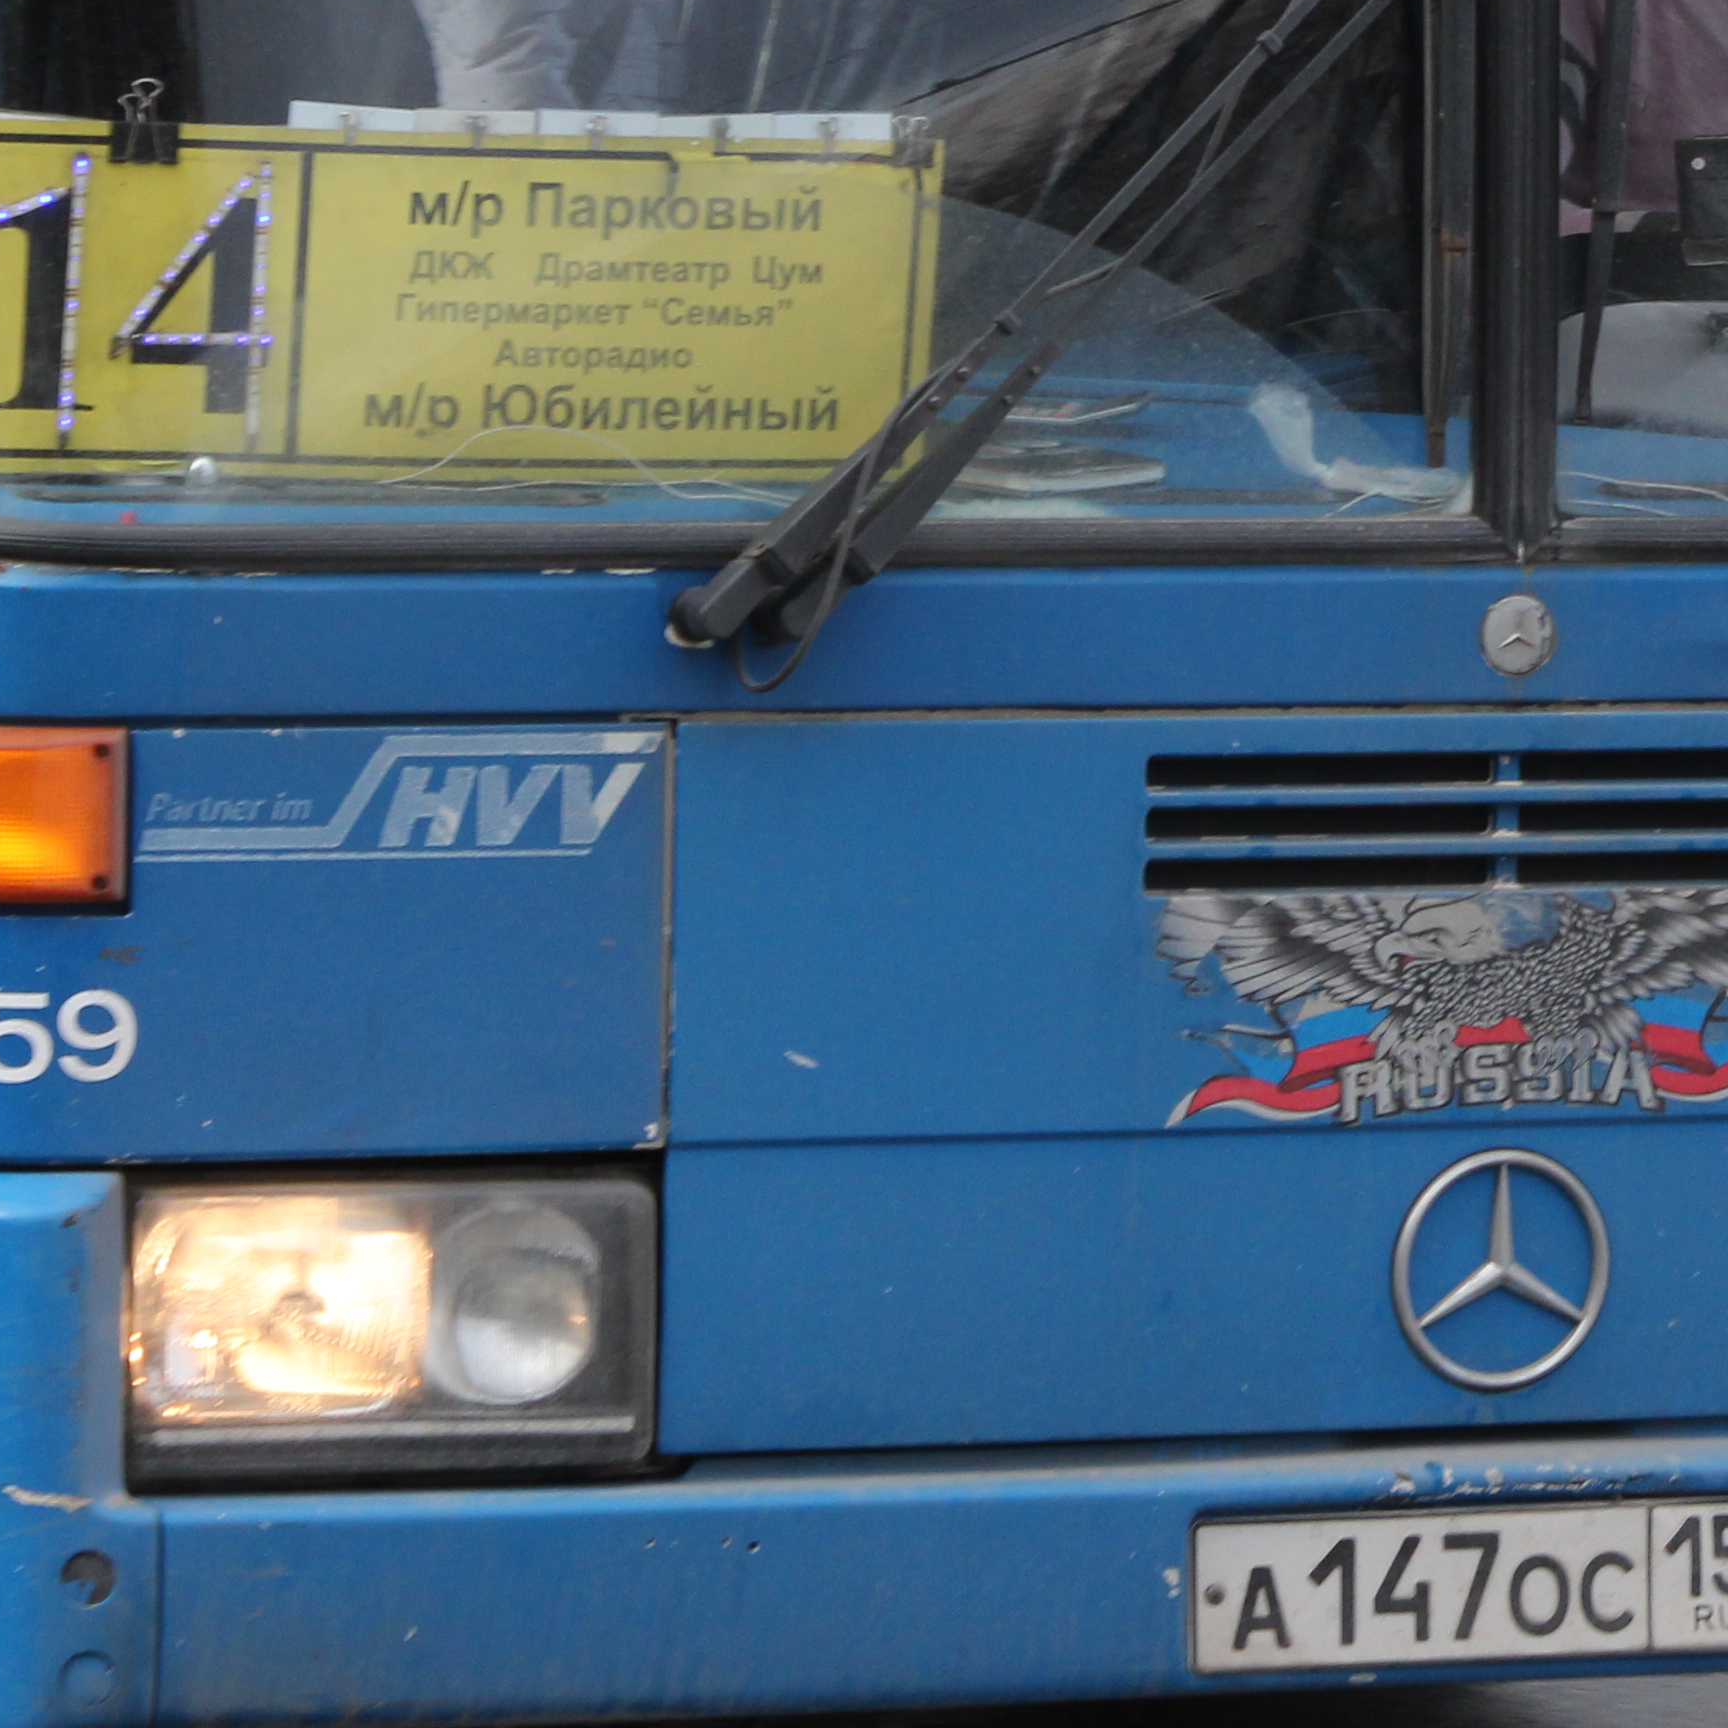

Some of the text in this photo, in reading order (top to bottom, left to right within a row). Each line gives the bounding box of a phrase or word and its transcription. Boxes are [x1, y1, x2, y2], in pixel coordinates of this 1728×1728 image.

[408, 180, 823, 241] м/р Парковый
[534, 251, 731, 291] Драмтеатр
[751, 255, 823, 291] Цум
[393, 291, 633, 330] Гипермаркет
[492, 337, 694, 374] Авторадио
[480, 383, 841, 432] Юбилейный
[144, 761, 646, 849] Partner im HVV
[1336, 1040, 1665, 1125] RUSSIA
